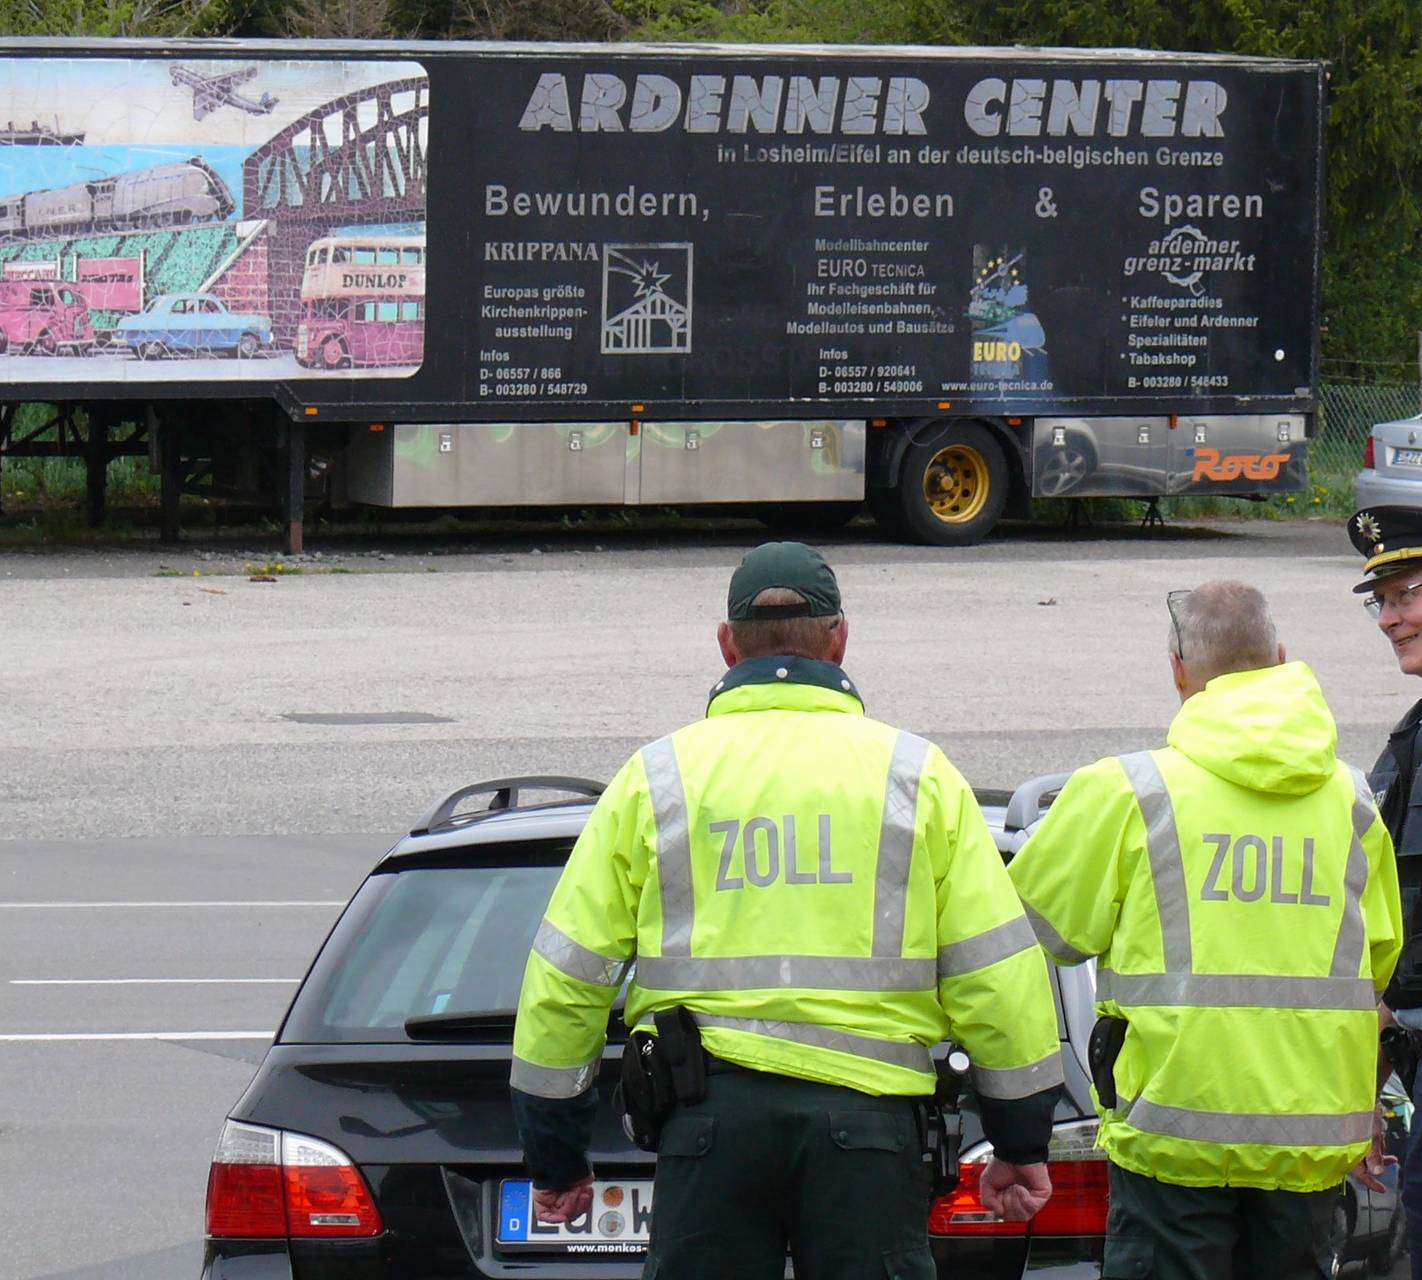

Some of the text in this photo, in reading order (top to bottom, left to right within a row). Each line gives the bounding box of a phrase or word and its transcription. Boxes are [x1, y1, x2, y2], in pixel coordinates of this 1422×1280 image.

[518, 72, 1228, 138] ARDENNER CENTER
[717, 144, 1224, 169] in Losheim/Eifel an der deutsch-belgischen Grenze
[485, 185, 1263, 224] Bewundern, Erleben & Sparen
[484, 242, 599, 261] KRIPPANA
[815, 238, 929, 252] Modellbahncenter
[1148, 236, 1239, 255] ardenner
[817, 259, 925, 277] EURO TECNICA
[342, 273, 407, 289] DUNLOP
[484, 285, 585, 302] Europas größte
[807, 282, 936, 297] Ihr Fachgeschäft für
[1131, 296, 1223, 310] Kaffeeparadies
[481, 305, 588, 321] Kirchenkrippen-
[1130, 315, 1258, 327] Eifeler und Ardenner
[495, 325, 573, 341] ausstellung
[786, 321, 865, 335] Modellautos
[869, 321, 893, 334] und
[1128, 334, 1207, 347] Spezialitäten
[480, 350, 510, 362] Infos
[819, 348, 848, 361] Infos
[973, 341, 1021, 362] EURO
[1129, 353, 1196, 367] Tabakshop
[496, 367, 530, 380] 06557
[709, 814, 853, 892] ZOLL
[1201, 833, 1330, 907] ZOLL
[509, 1218, 520, 1231] D
